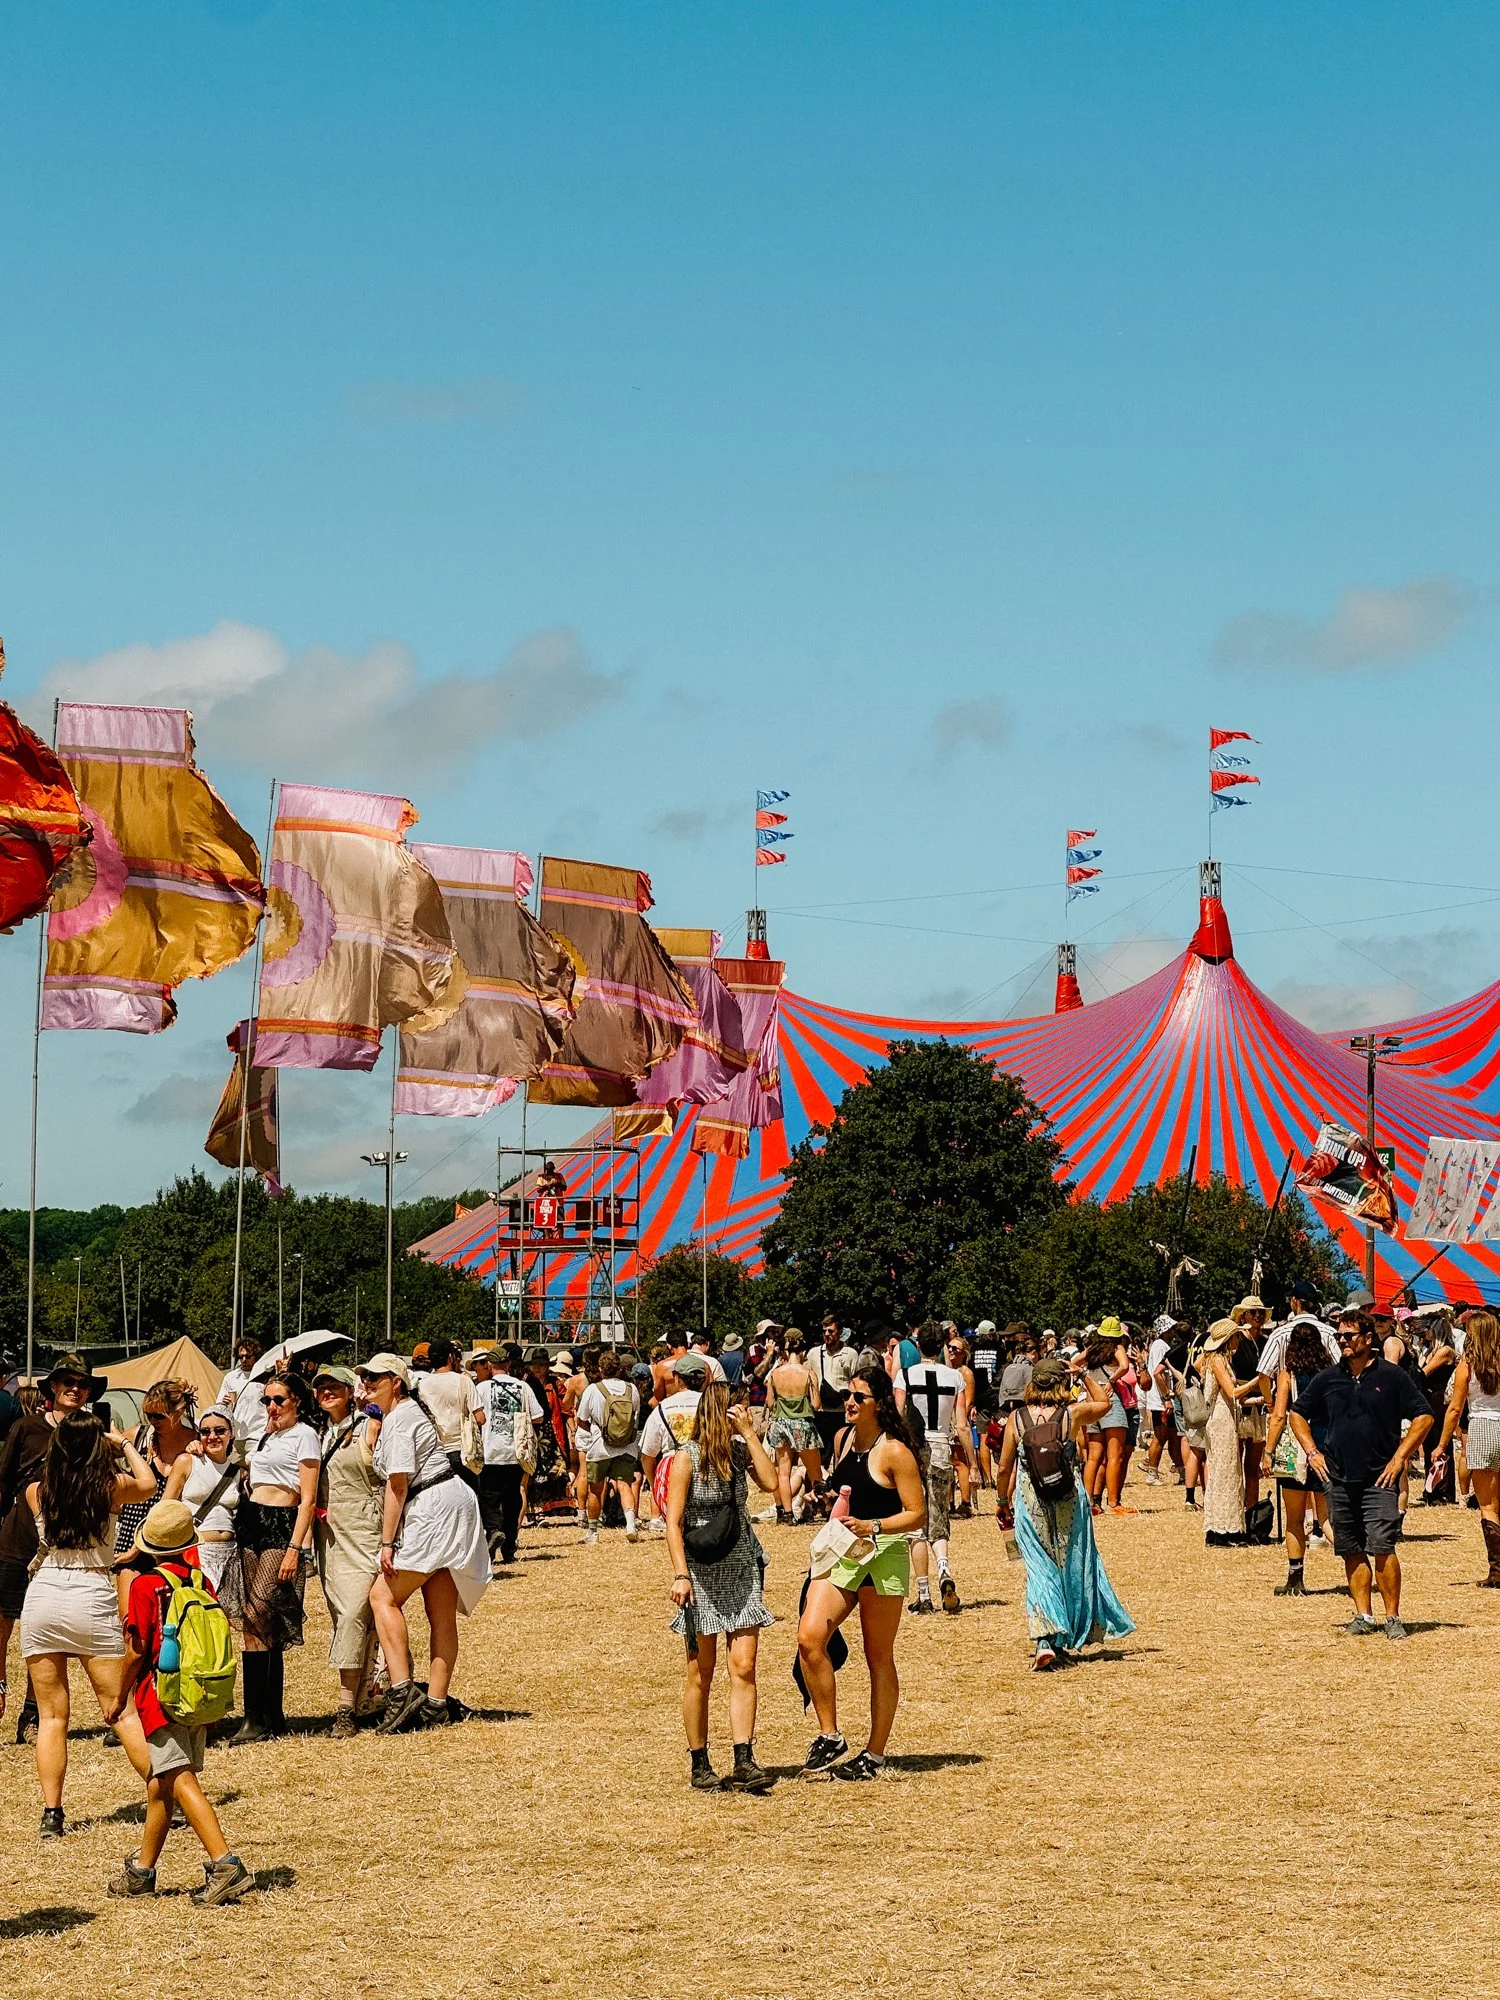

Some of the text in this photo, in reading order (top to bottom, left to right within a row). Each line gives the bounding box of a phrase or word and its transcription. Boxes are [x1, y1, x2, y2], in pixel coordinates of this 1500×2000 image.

[1347, 1149, 1367, 1170] UP!
[1322, 1183, 1360, 1205] BIRTHDAY
[542, 1214, 548, 1225] 3
